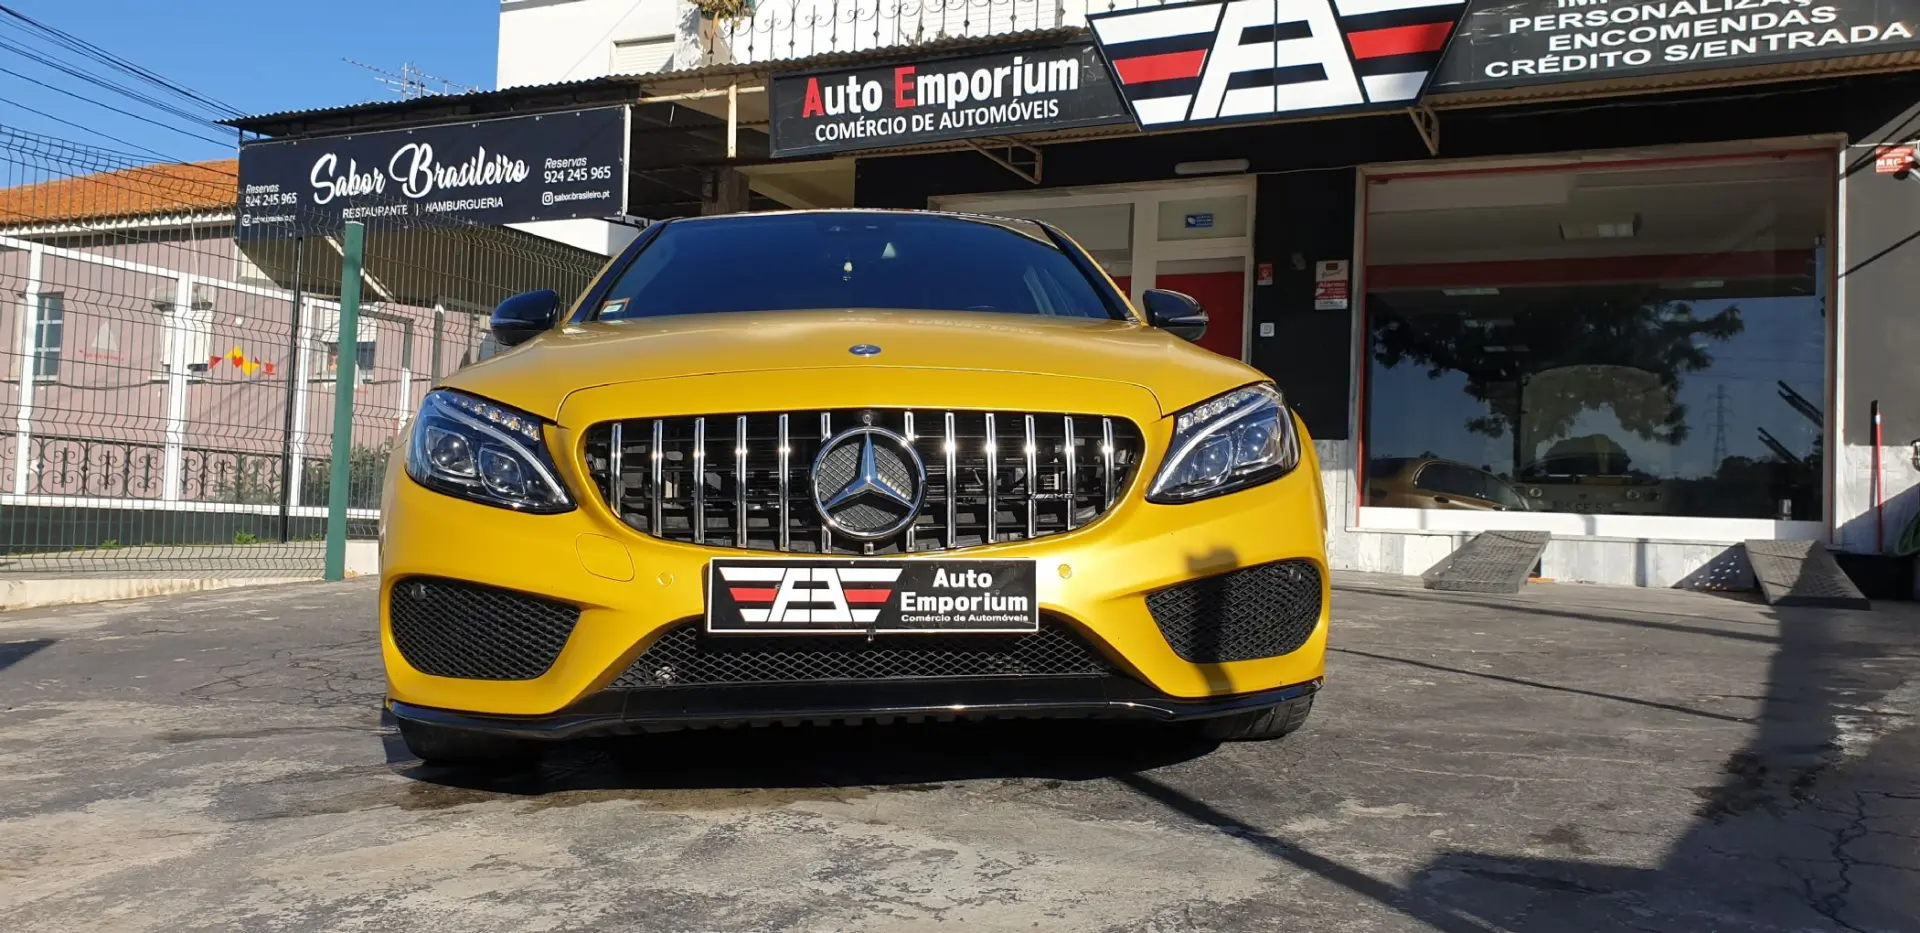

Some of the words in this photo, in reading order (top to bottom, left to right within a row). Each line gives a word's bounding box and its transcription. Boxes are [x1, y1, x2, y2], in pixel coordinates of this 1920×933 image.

[1549, 6, 1837, 51] ENCOMENDAS
[1484, 48, 1652, 78] CRÉDITO
[1664, 22, 1913, 61] S/ENTRADA
[802, 75, 882, 118] Auto
[894, 56, 1079, 109] Emporium
[815, 115, 906, 142] COMÉRCIO
[911, 112, 934, 132] DE
[938, 98, 1059, 130] AUTOMÓVEIS
[310, 153, 386, 204] Sabor
[388, 143, 529, 199] Brasileiro
[545, 157, 587, 169] Reservas
[544, 170, 564, 183] 924
[567, 168, 588, 181] 245
[591, 166, 611, 180] 965
[245, 195, 260, 207] 924
[262, 194, 279, 205] 245
[281, 192, 297, 205] 965
[246, 184, 280, 194] Reservas
[342, 204, 409, 219] RESTAURANTE
[425, 196, 504, 213] HAMBURGUERIA
[932, 568, 993, 588] Auto
[900, 592, 1028, 614] Emporium
[901, 614, 951, 622] Comércio
[968, 614, 1029, 622] Automóveis
